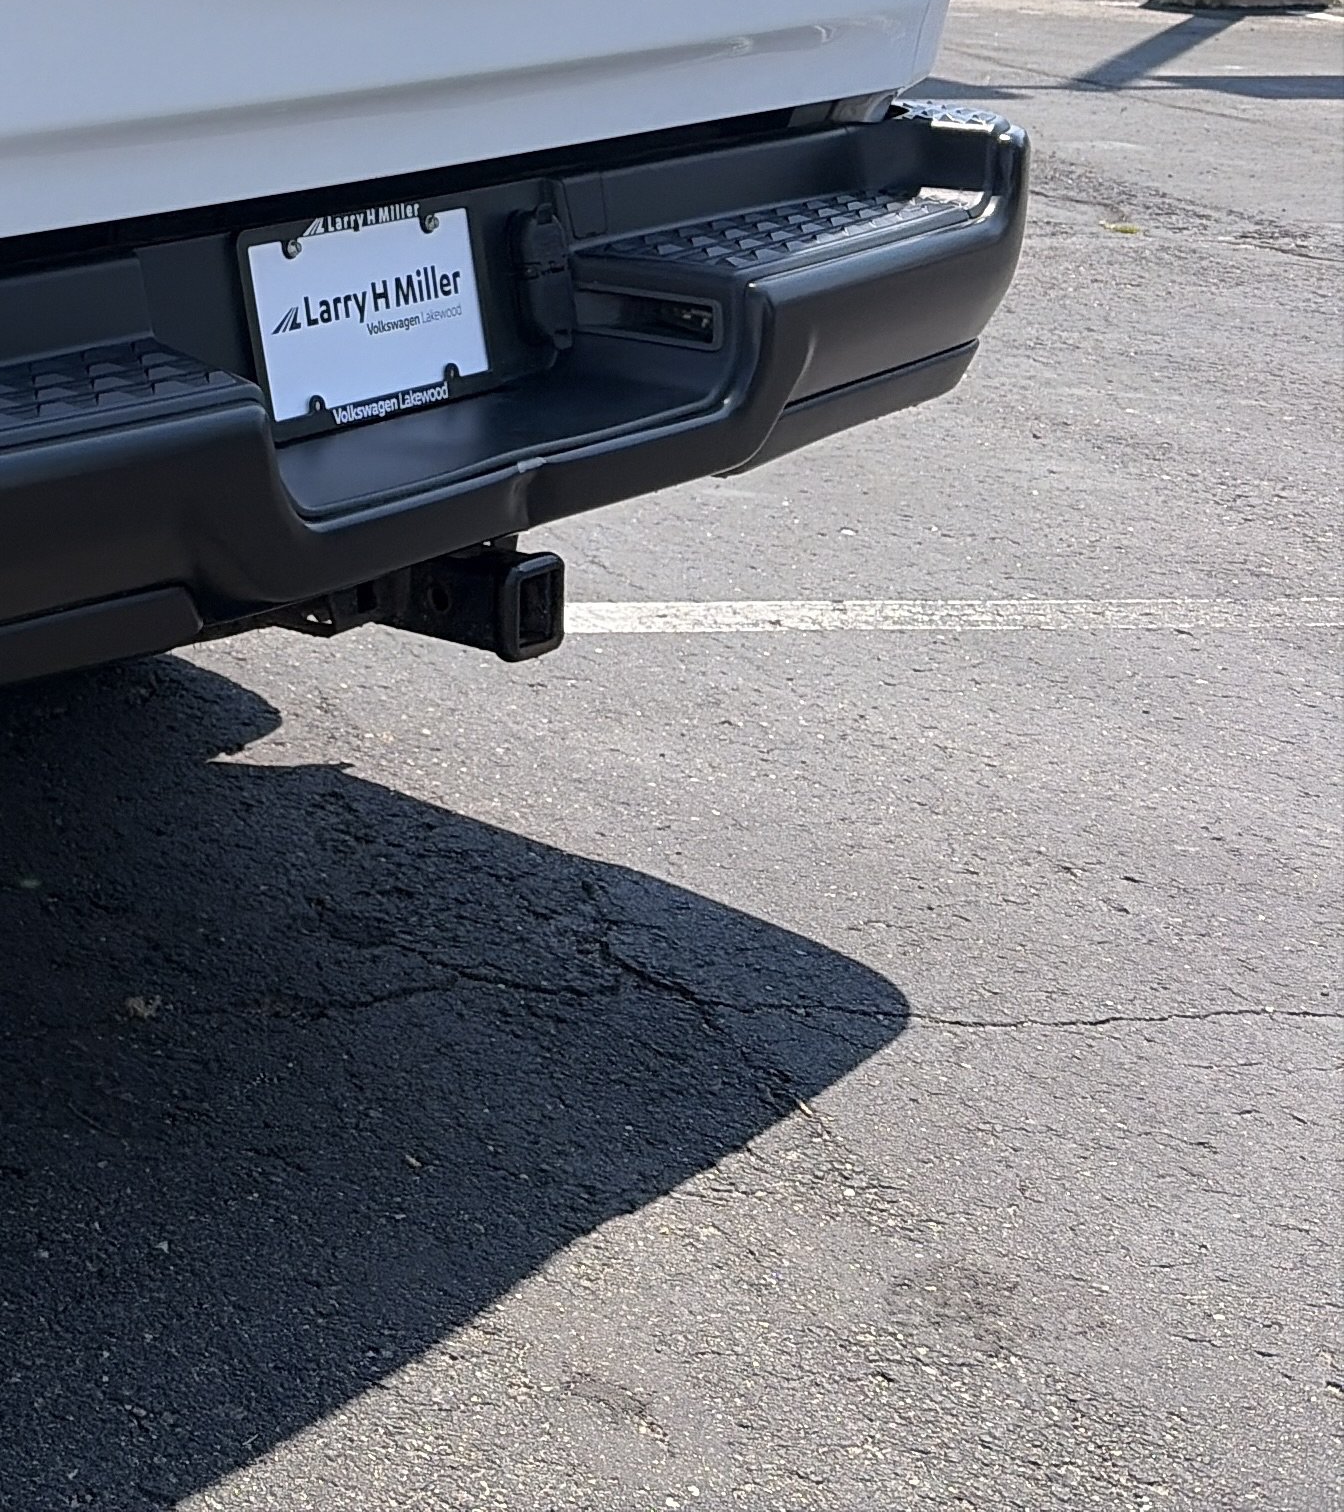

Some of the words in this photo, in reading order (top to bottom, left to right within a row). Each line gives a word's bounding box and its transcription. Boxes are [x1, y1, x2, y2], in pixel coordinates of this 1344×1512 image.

[327, 213, 364, 232] Larry
[366, 208, 376, 226] H
[378, 202, 420, 223] Miller
[303, 290, 367, 327] Larry
[371, 279, 390, 313] H
[394, 265, 461, 308] Miller
[367, 313, 421, 336] Volkswagen
[421, 304, 462, 325] Lakewood
[332, 398, 399, 425] Volkswagen
[398, 381, 449, 410] Lakewood
